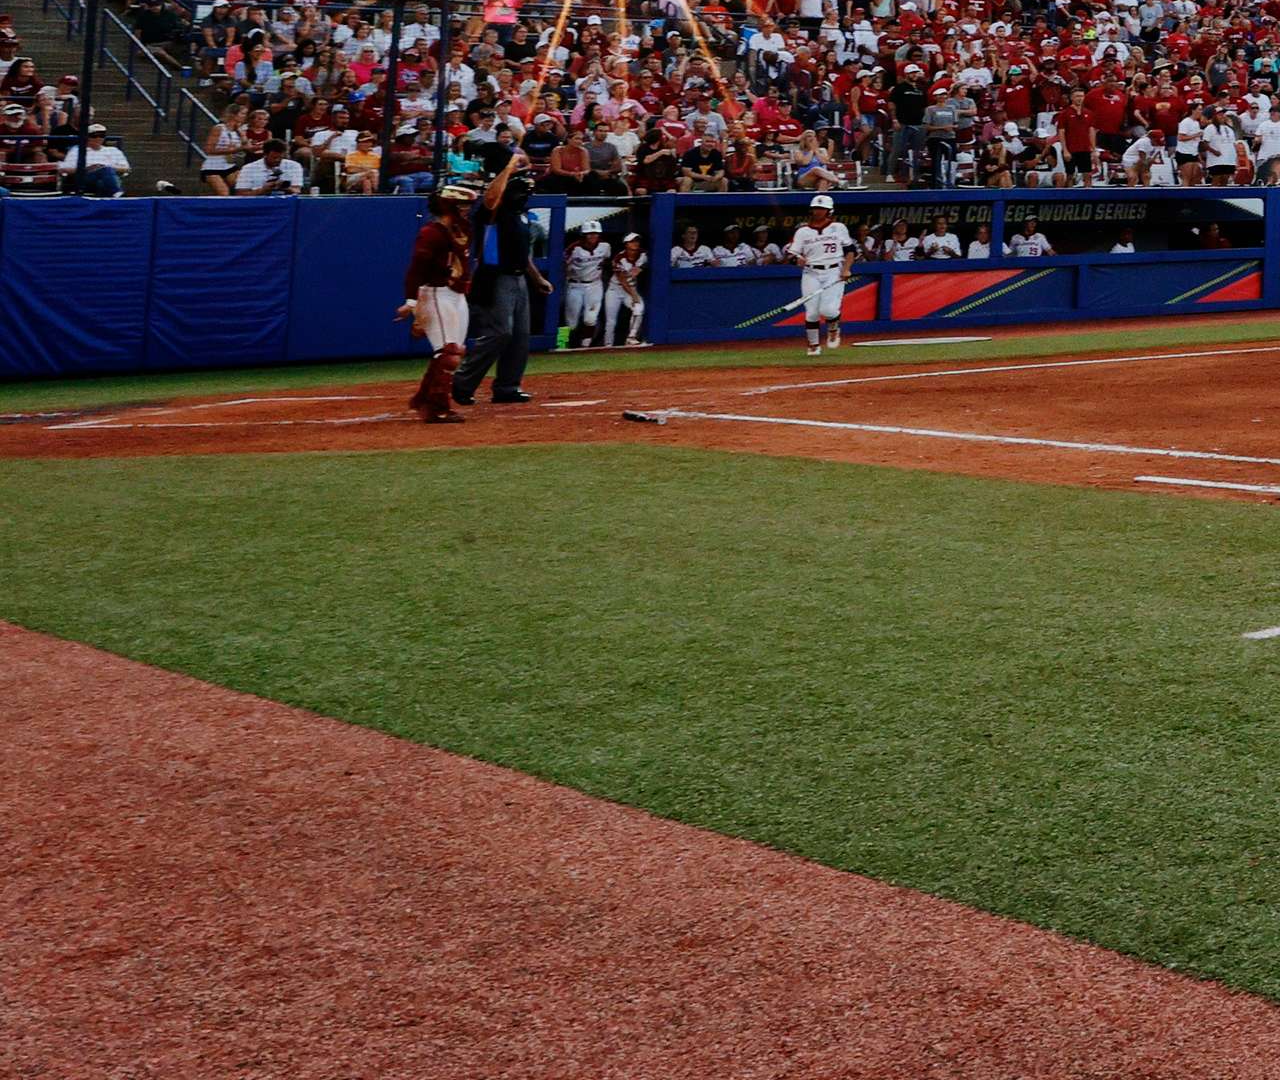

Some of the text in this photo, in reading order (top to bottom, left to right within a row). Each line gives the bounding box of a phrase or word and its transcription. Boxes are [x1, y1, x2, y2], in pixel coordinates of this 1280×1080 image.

[879, 206, 960, 224] WOMEN'S
[1038, 204, 1092, 221] WORLD
[1095, 203, 1148, 220] SERIES
